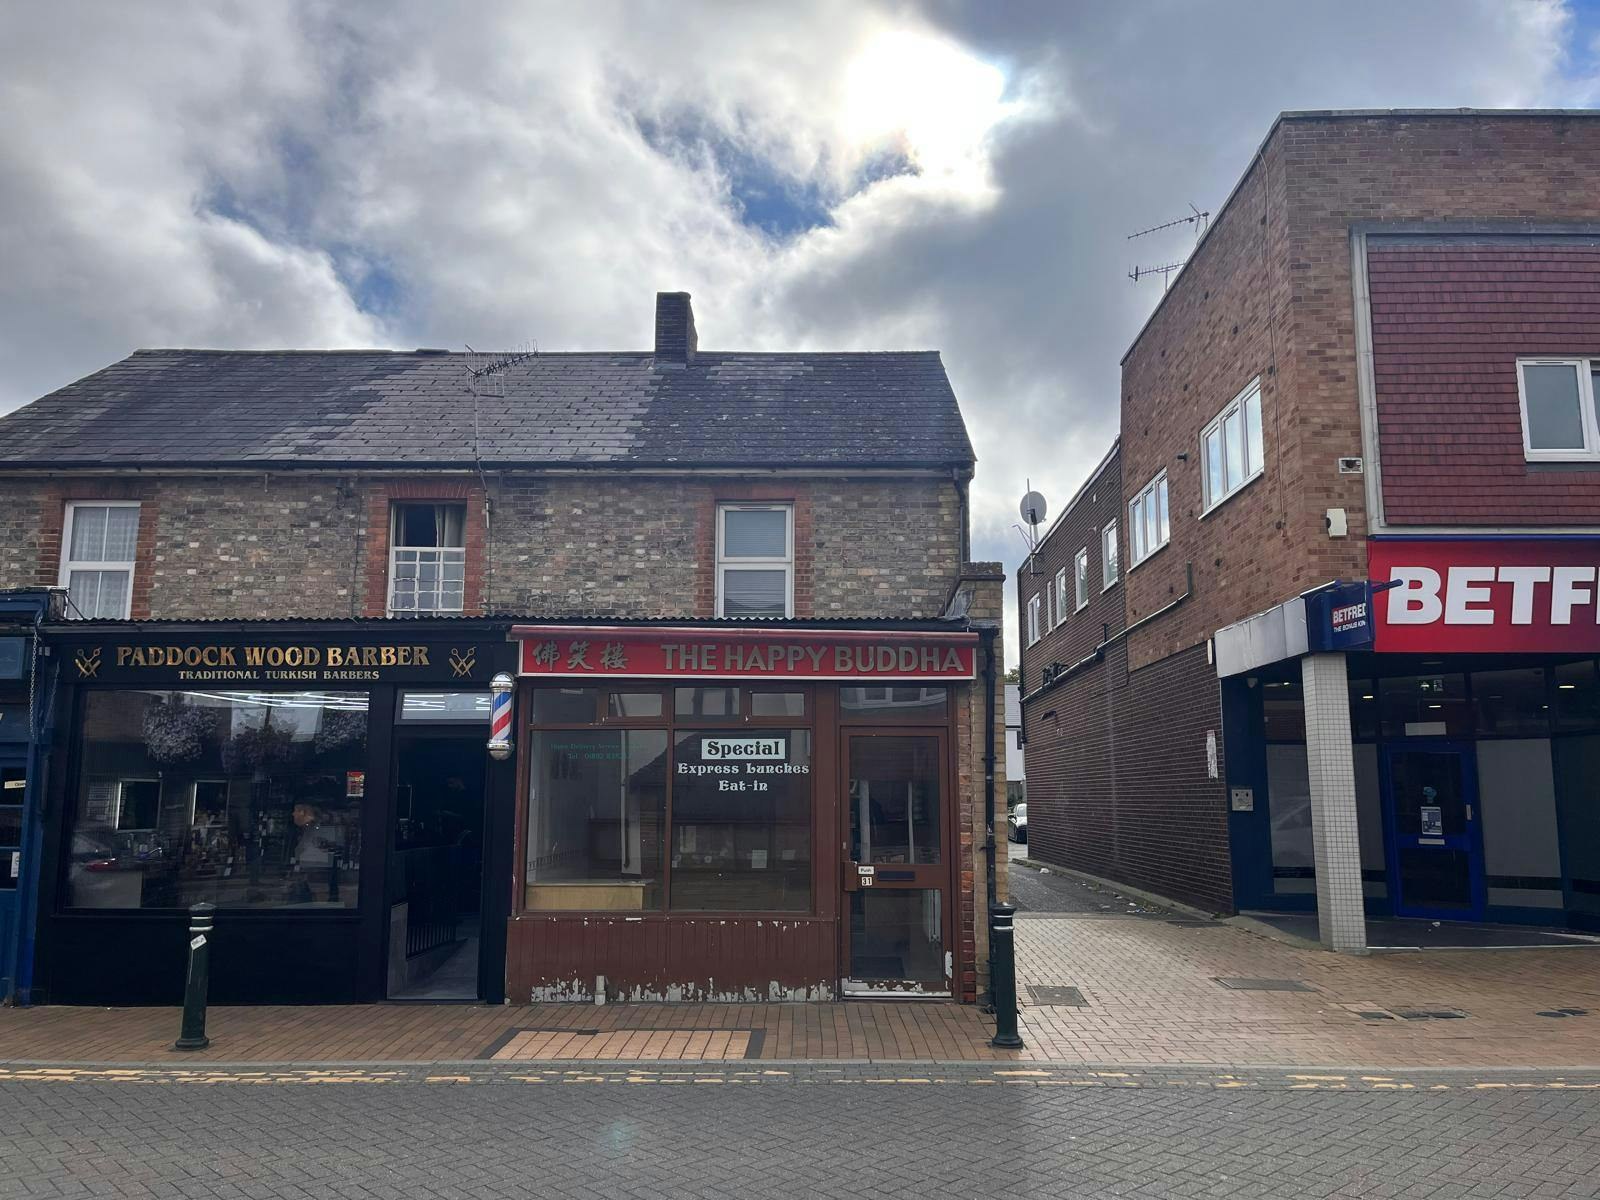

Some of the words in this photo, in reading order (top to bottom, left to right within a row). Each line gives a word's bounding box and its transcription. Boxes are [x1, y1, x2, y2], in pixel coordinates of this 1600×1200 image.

[1386, 566, 1600, 625] BETF
[116, 646, 237, 666] PADDOCK
[244, 646, 321, 666] WOOD
[326, 646, 430, 666] BARBER
[660, 644, 716, 670] THE
[723, 645, 828, 672] HAPPY
[833, 646, 965, 672] BUDDHA
[178, 670, 260, 680] TRADITIONAL
[264, 670, 317, 680] TURKISH
[323, 670, 380, 680] BARBERS
[707, 740, 780, 758] Special
[677, 762, 740, 776] Express
[745, 762, 810, 774] Lunches
[718, 780, 768, 791] Eat-in
[862, 877, 871, 885] 31
